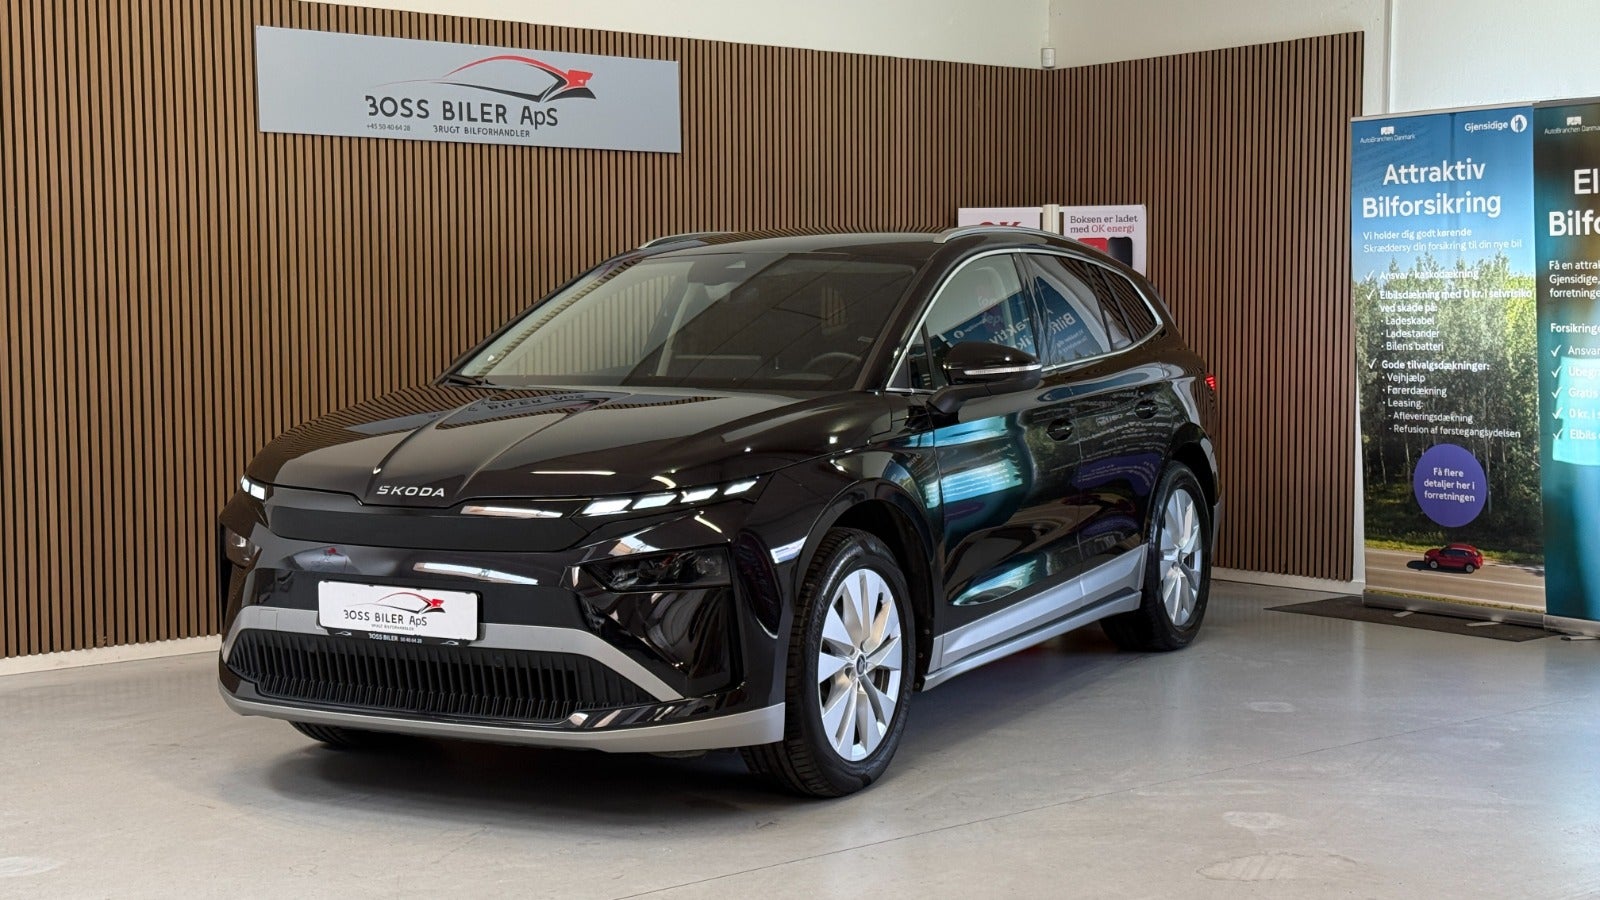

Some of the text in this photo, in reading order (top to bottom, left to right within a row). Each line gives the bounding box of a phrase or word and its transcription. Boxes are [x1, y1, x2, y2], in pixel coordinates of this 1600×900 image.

[442, 100, 508, 124] BILER
[520, 105, 558, 130] ApS
[1464, 120, 1509, 132] Gjensidige
[464, 126, 530, 138] BILFORHANDLER
[1360, 132, 1416, 144] AutoBranchen Danmark
[1382, 158, 1486, 186] Attraktiv
[1574, 168, 1599, 194] El
[1362, 190, 1501, 218] Bilforsikring
[1070, 215, 1102, 224] Boksen
[1115, 215, 1138, 223] ladet
[1070, 225, 1090, 234] med
[1106, 224, 1135, 234] energi
[1363, 228, 1472, 240] Vi holder dig godt kørende
[1364, 240, 1522, 254] Skræddersy din forsikring til din nye bil
[1549, 260, 1560, 270] Få
[1380, 290, 1440, 301] Elbilsdækning
[1441, 290, 1461, 300] med
[1464, 290, 1469, 298] 0
[1472, 290, 1483, 298] kr.
[1488, 289, 1532, 298] selvrisiko
[1380, 304, 1396, 312] ved
[1398, 304, 1423, 312] skade
[1386, 317, 1434, 325] Ladeskabel
[1386, 330, 1440, 338] Ladestander
[1386, 342, 1444, 350] Bilens batteri
[1382, 360, 1490, 371] Gode tilvalgsdækninger:
[1387, 373, 1426, 383] Vejhjælp
[1387, 386, 1447, 397] Førerdækning
[1388, 399, 1423, 409] Leasing:
[1393, 413, 1473, 424] Afleveringsdækning
[1394, 425, 1428, 434] Refusion
[1433, 467, 1464, 477] Få flere
[1424, 479, 1475, 490] detaljer her i
[1424, 490, 1475, 503] forretningen
[374, 612, 404, 624] BILER
[409, 615, 427, 627] ApS
